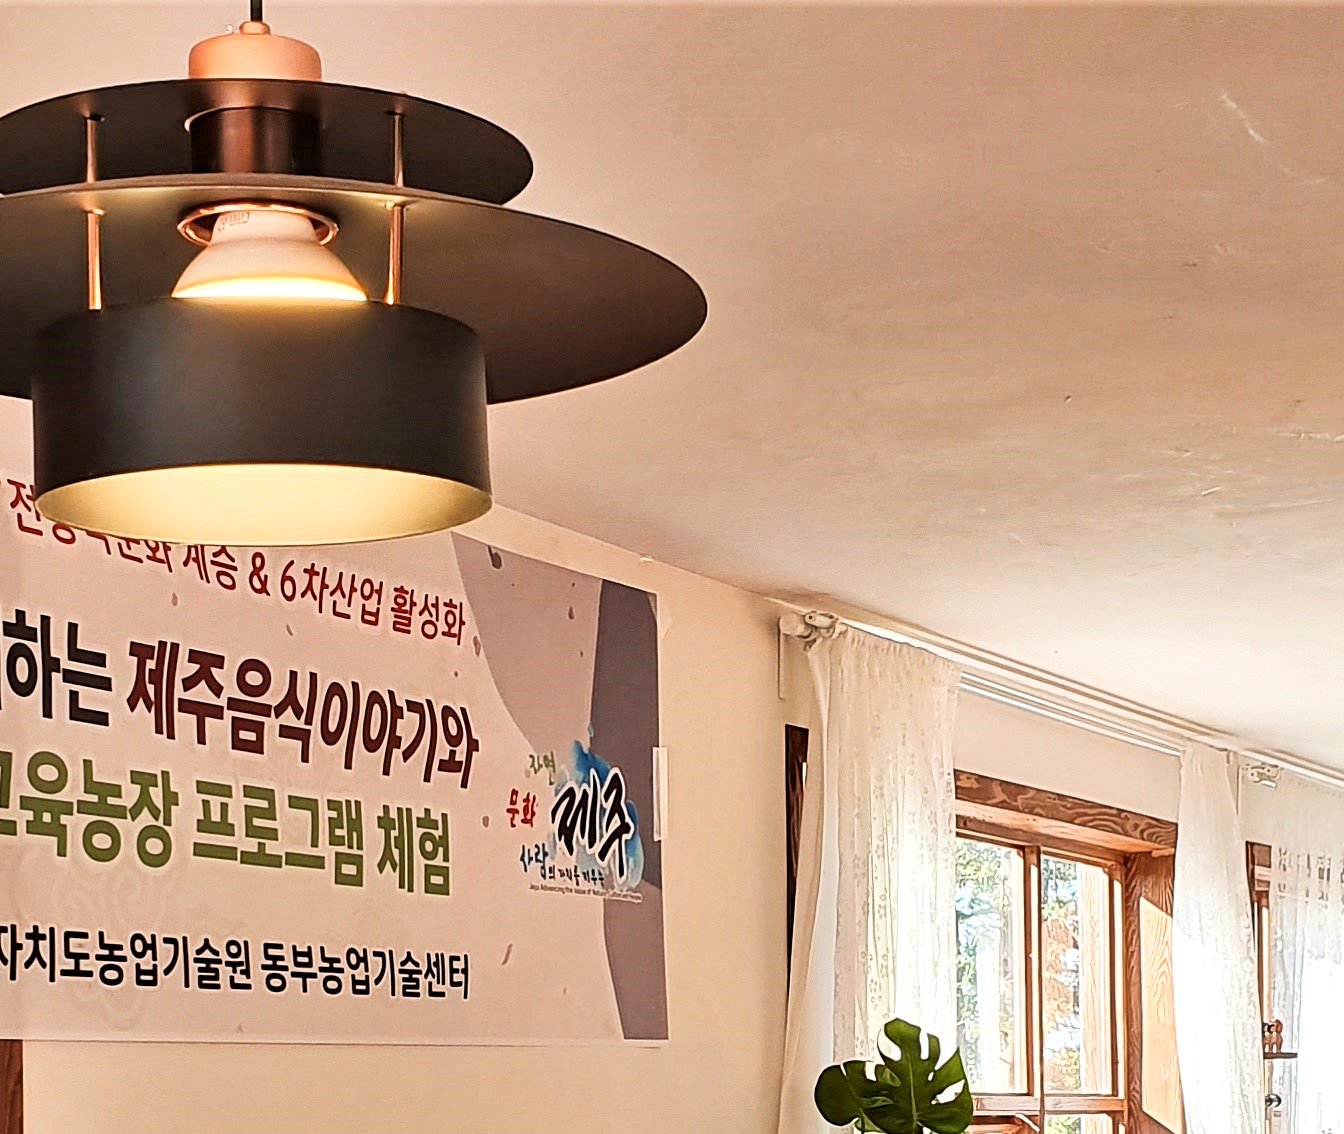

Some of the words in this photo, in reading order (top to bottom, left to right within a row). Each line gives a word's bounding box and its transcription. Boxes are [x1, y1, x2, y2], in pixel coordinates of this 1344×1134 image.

[248, 551, 271, 596] &
[280, 559, 384, 626] 6차산업
[390, 585, 466, 645] 활성화
[126, 639, 479, 789] 제주음식이야기와
[192, 778, 365, 888] 프로그램
[376, 803, 451, 897] 체험
[506, 788, 537, 828] 문화
[550, 770, 632, 879] 제주
[260, 941, 471, 999] 동부농업기술센터
